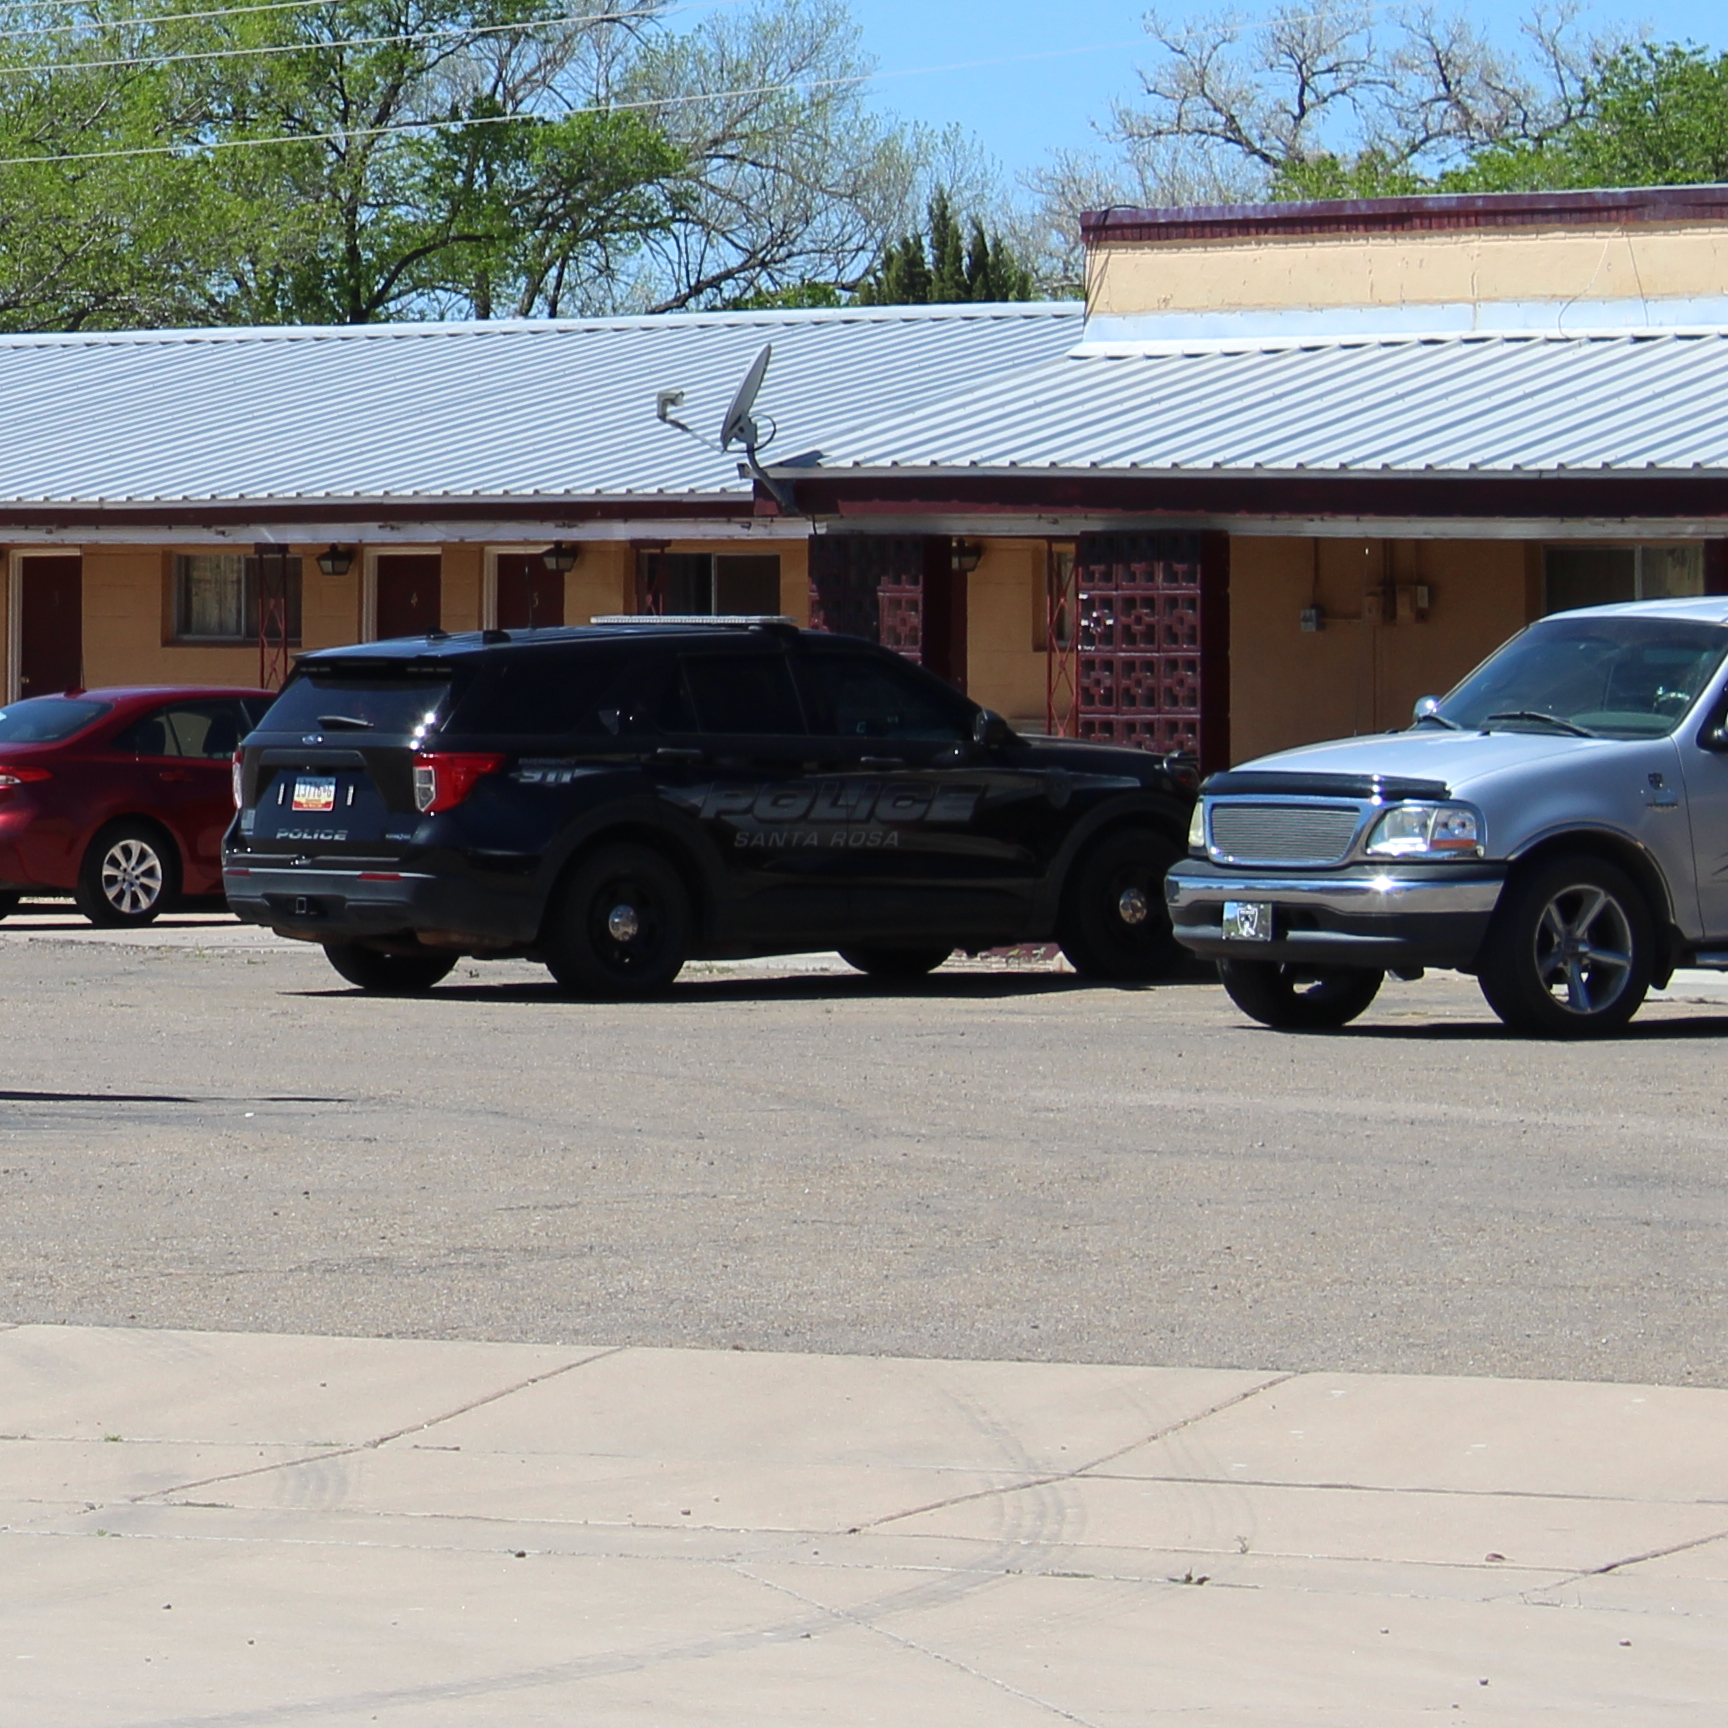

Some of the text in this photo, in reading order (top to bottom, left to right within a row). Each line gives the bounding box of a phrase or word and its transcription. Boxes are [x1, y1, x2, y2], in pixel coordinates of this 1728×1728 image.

[699, 780, 983, 822] POLICE
[275, 828, 348, 841] POLICE
[734, 830, 900, 848] SANTA ROSA
